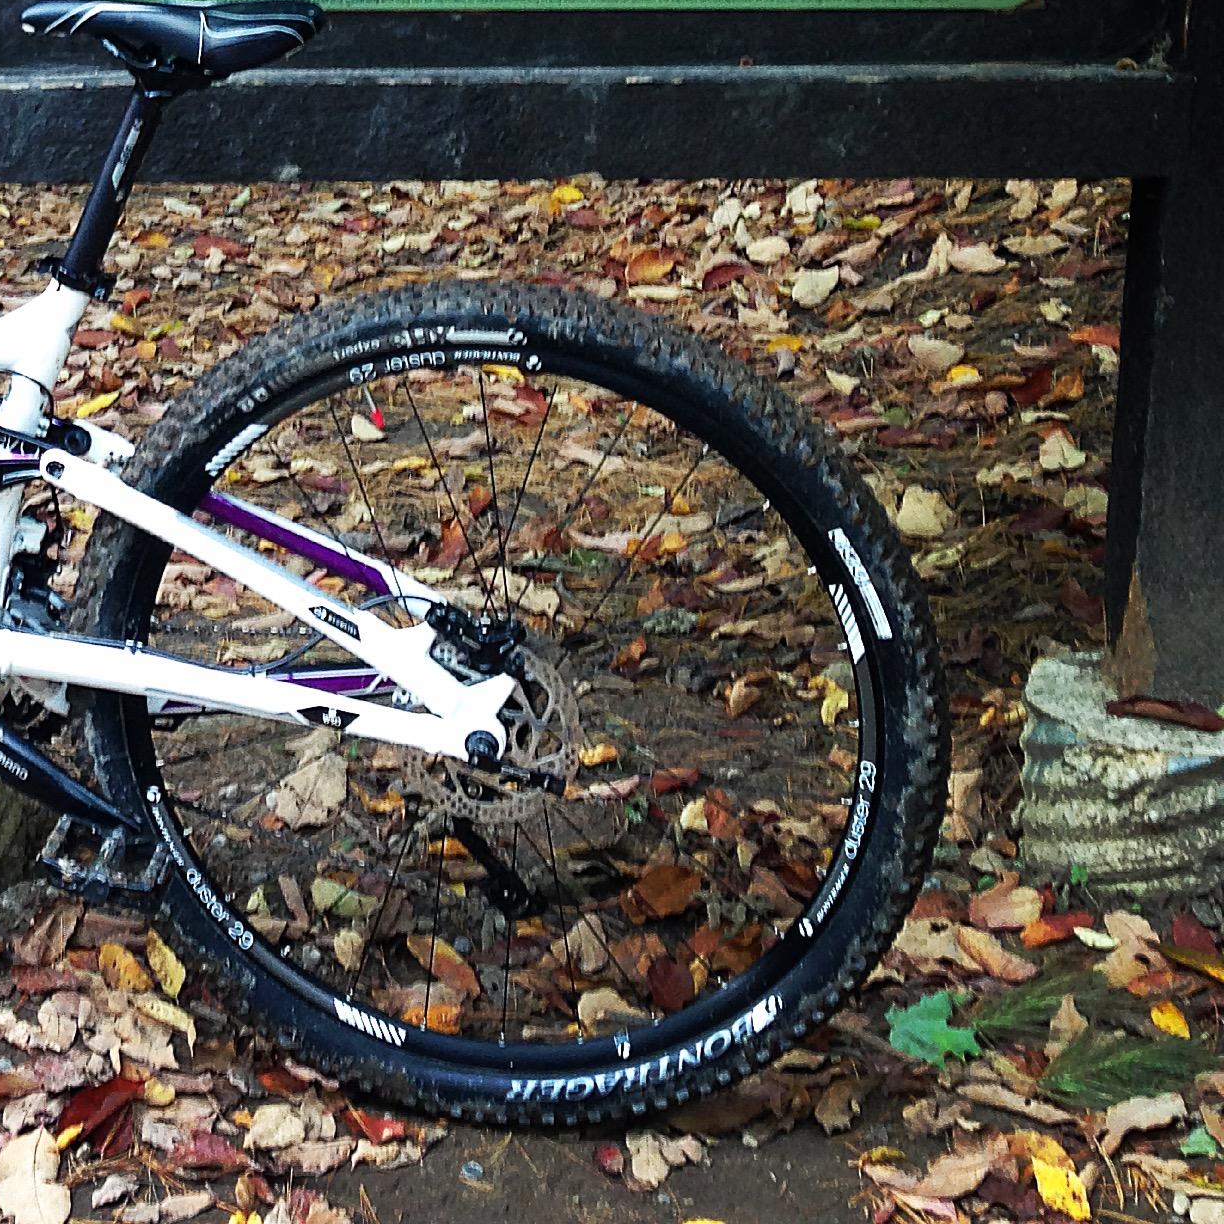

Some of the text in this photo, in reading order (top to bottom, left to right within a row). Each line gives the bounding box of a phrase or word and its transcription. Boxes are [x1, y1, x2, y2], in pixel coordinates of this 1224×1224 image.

[349, 362, 377, 385] 29
[859, 760, 877, 794] 29
[504, 1015, 755, 1104] BONTRAGER
